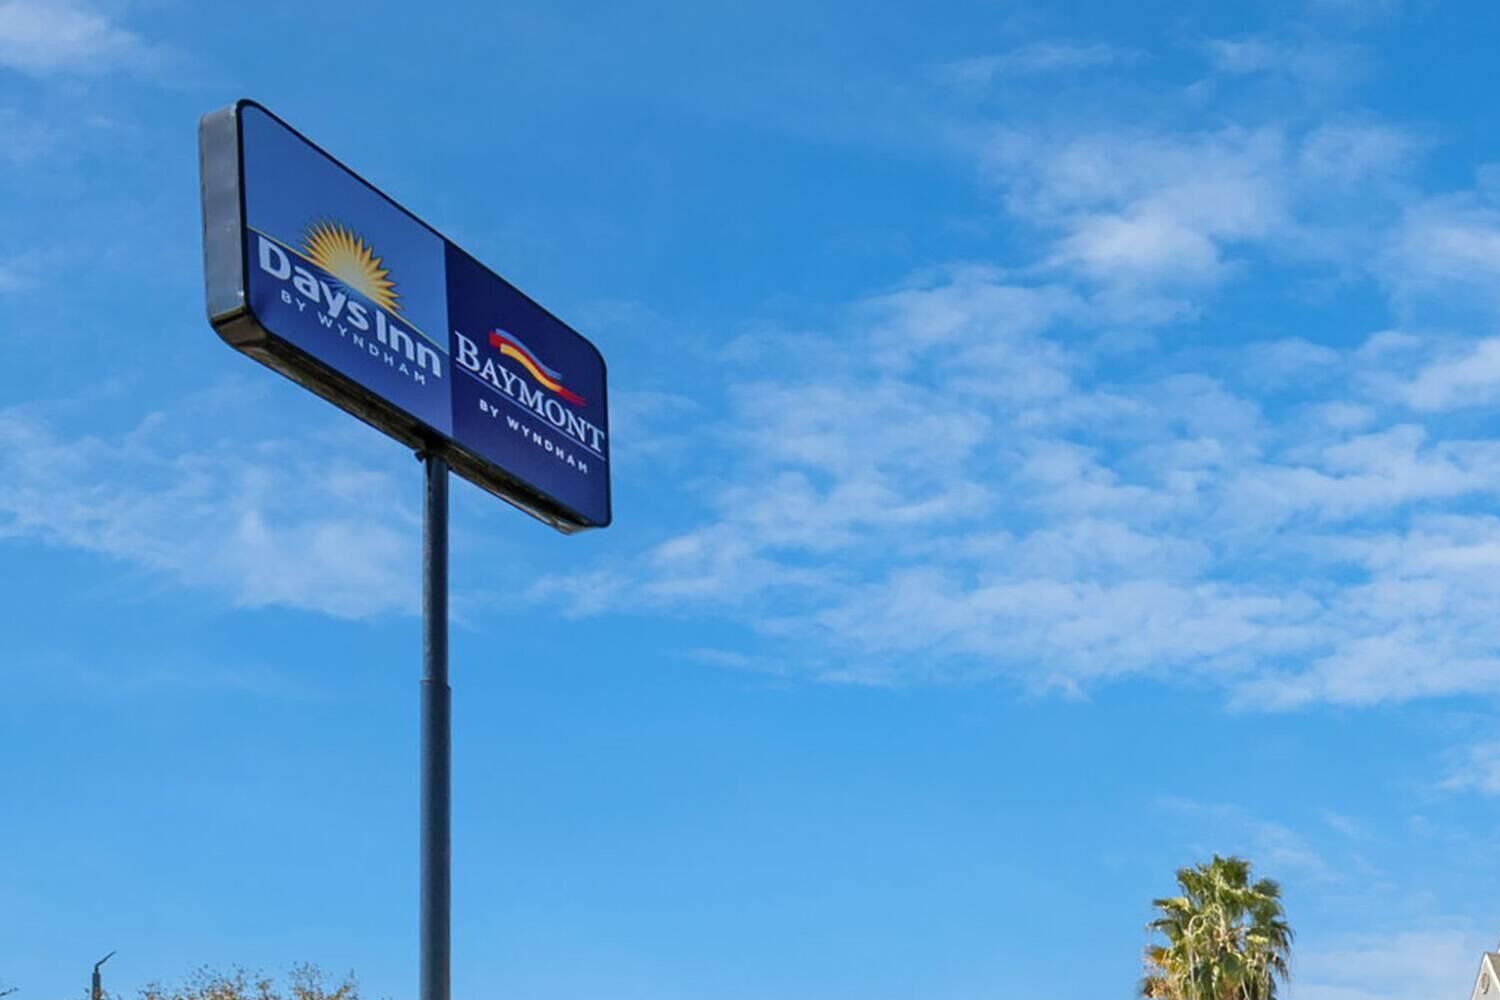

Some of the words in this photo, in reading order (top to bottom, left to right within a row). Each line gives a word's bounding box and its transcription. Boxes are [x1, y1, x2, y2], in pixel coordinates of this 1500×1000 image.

[258, 236, 369, 332] Days
[376, 309, 442, 378] Inn
[281, 289, 306, 312] BY
[318, 311, 426, 385] WYNDHAM
[454, 330, 605, 453] BAYMONT
[479, 398, 499, 418] BY
[506, 415, 588, 474] WYNDHAM
